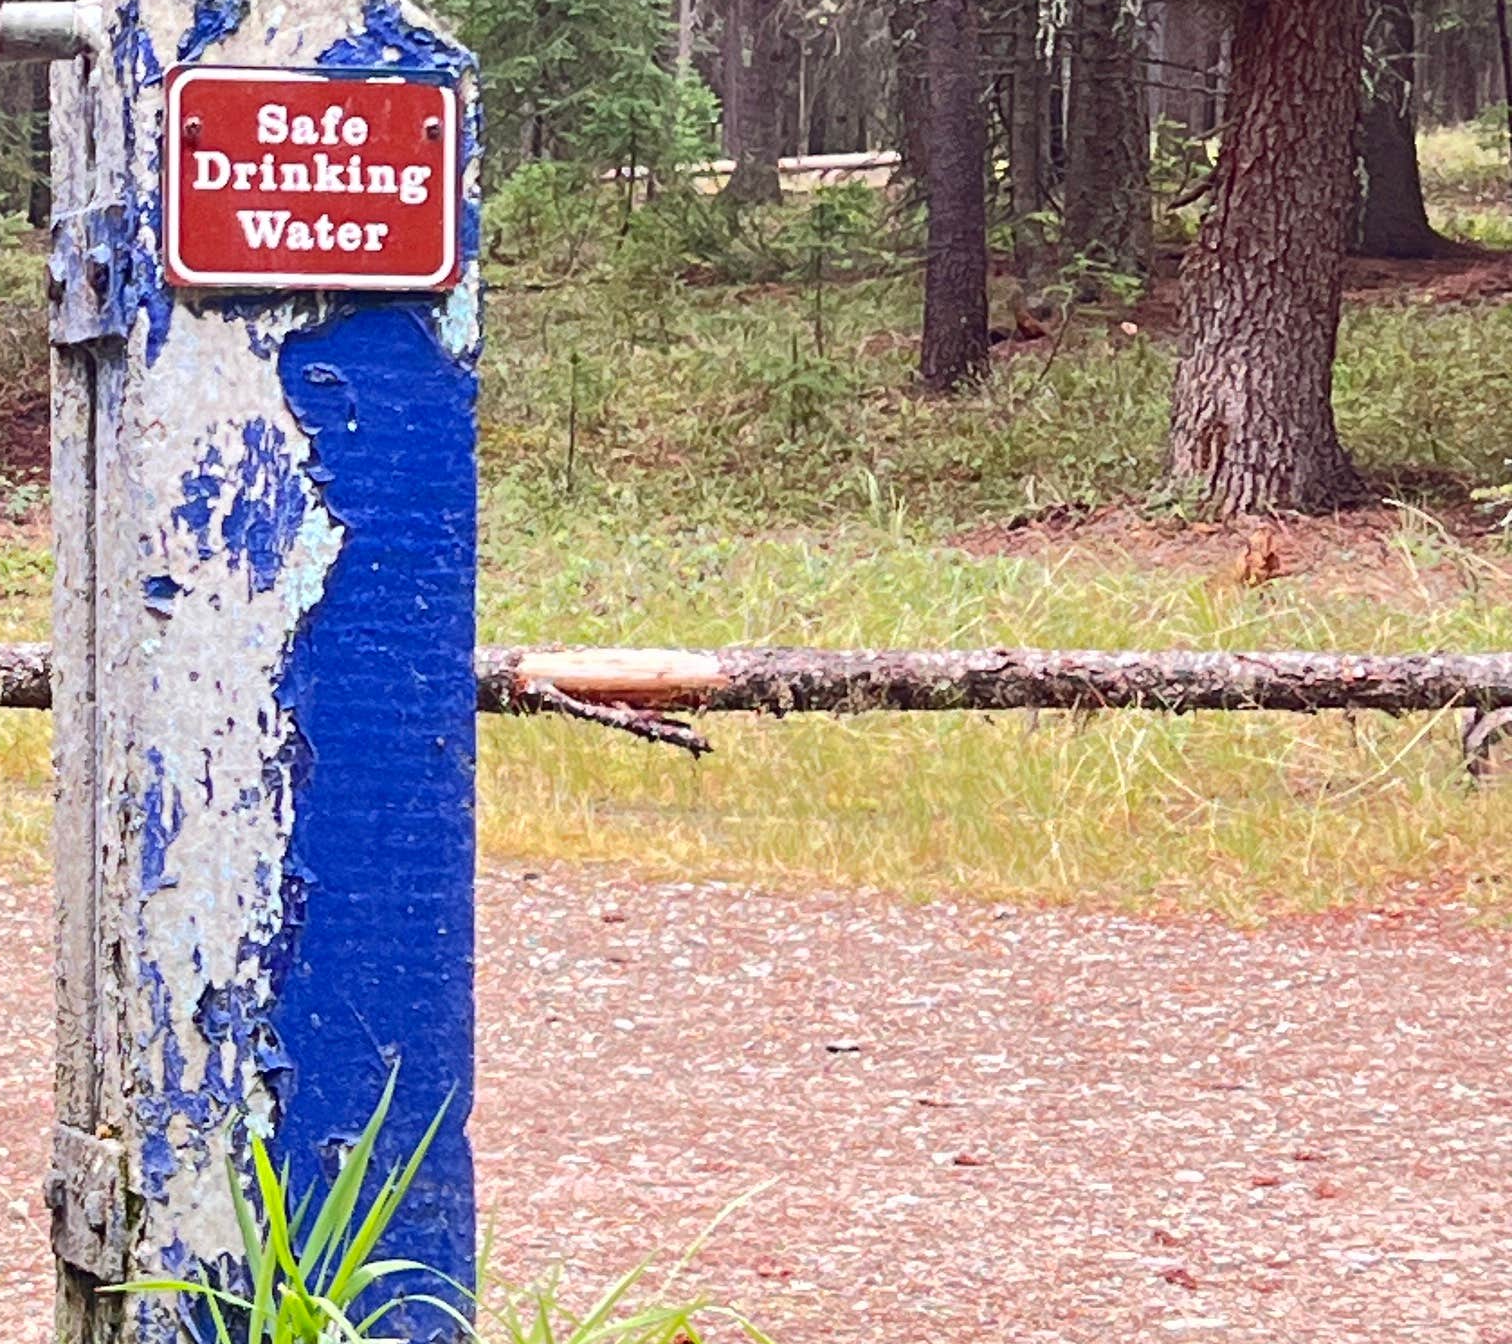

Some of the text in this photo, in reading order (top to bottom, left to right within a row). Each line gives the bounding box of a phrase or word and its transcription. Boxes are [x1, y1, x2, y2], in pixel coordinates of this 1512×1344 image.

[257, 103, 368, 146] Safe
[192, 151, 432, 205] Drinking
[236, 210, 389, 251] Water
